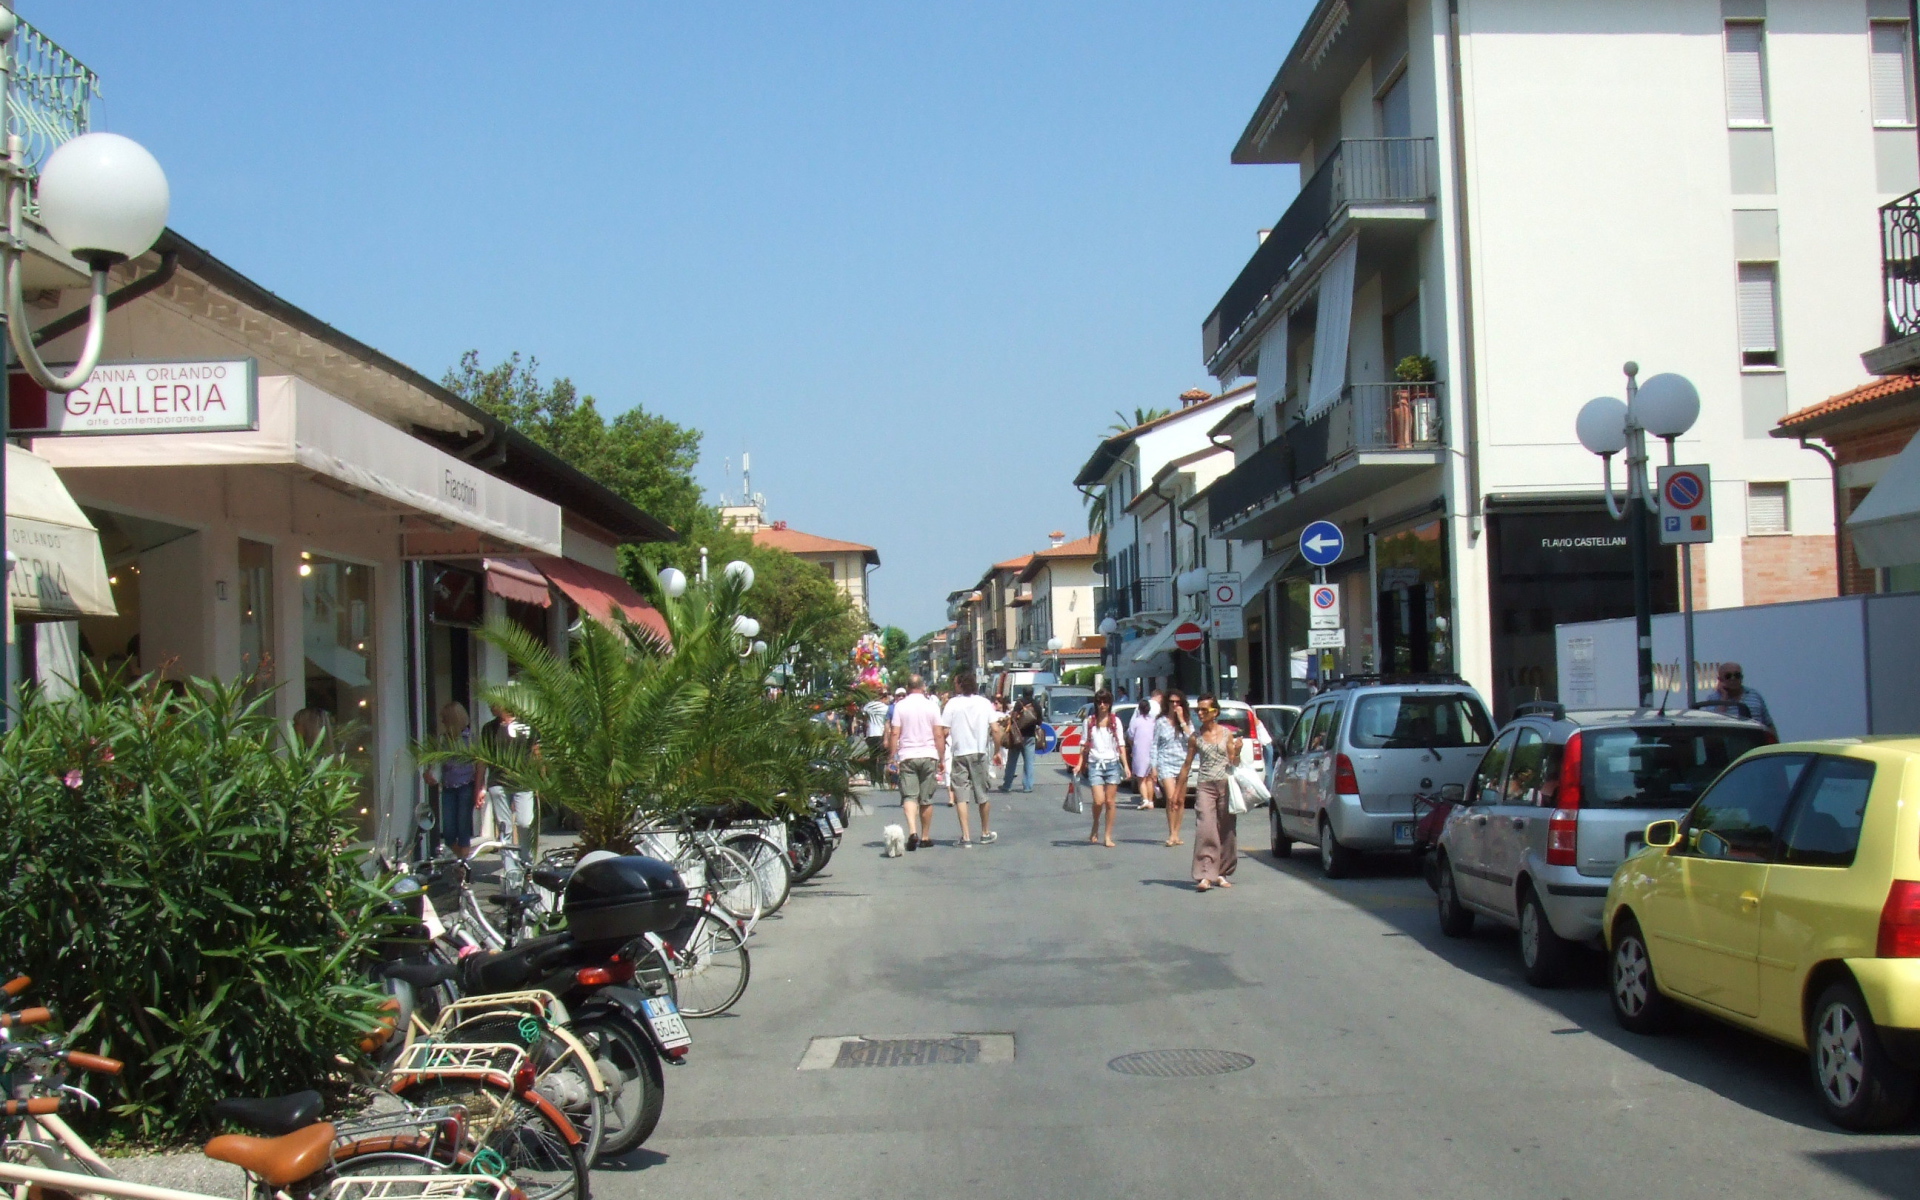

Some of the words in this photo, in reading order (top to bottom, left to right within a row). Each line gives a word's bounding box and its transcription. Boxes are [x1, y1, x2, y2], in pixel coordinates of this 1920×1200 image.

[146, 365, 227, 382] ORLANDO
[64, 383, 227, 416] GALLERIA
[86, 417, 110, 427] arte
[113, 414, 205, 427] contemporanea
[444, 468, 477, 508] Fiacchini
[12, 528, 61, 549] ORLANDO
[1541, 537, 1573, 548] FLAVIO
[1574, 536, 1627, 547] CASTELLANI
